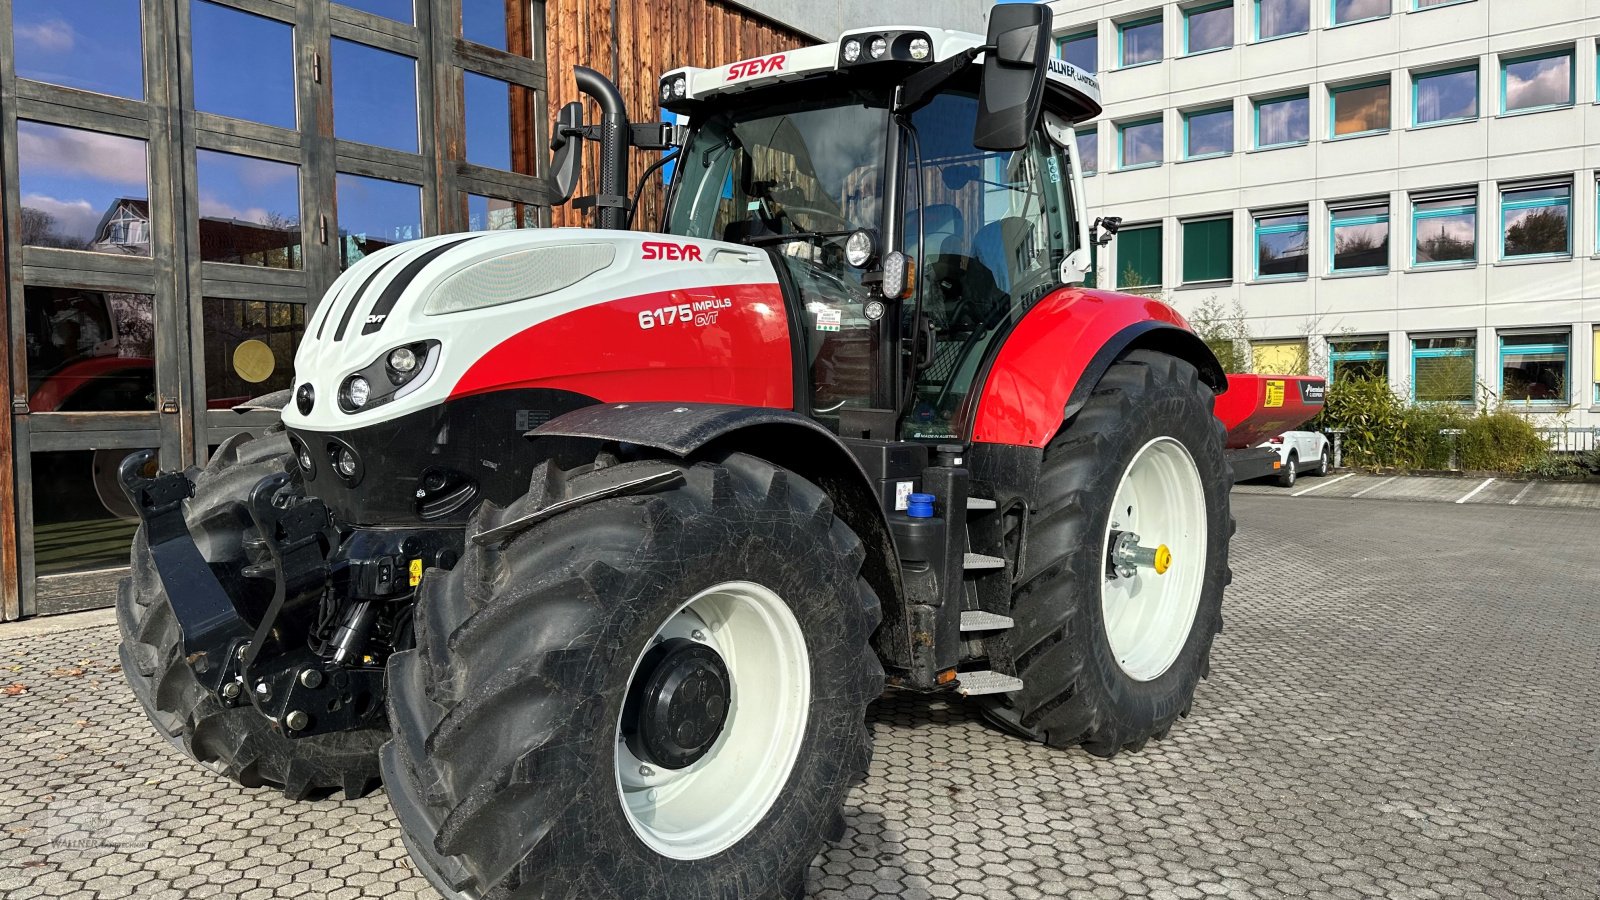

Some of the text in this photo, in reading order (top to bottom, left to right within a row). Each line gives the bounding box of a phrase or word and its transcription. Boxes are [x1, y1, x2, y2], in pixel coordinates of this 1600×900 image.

[726, 55, 785, 81] STEYR
[1047, 59, 1076, 81] ALLNER
[642, 242, 703, 262] STEYR
[365, 314, 387, 323] CVT
[638, 298, 732, 330] 6175 IMPULS
[694, 311, 719, 327] CVT
